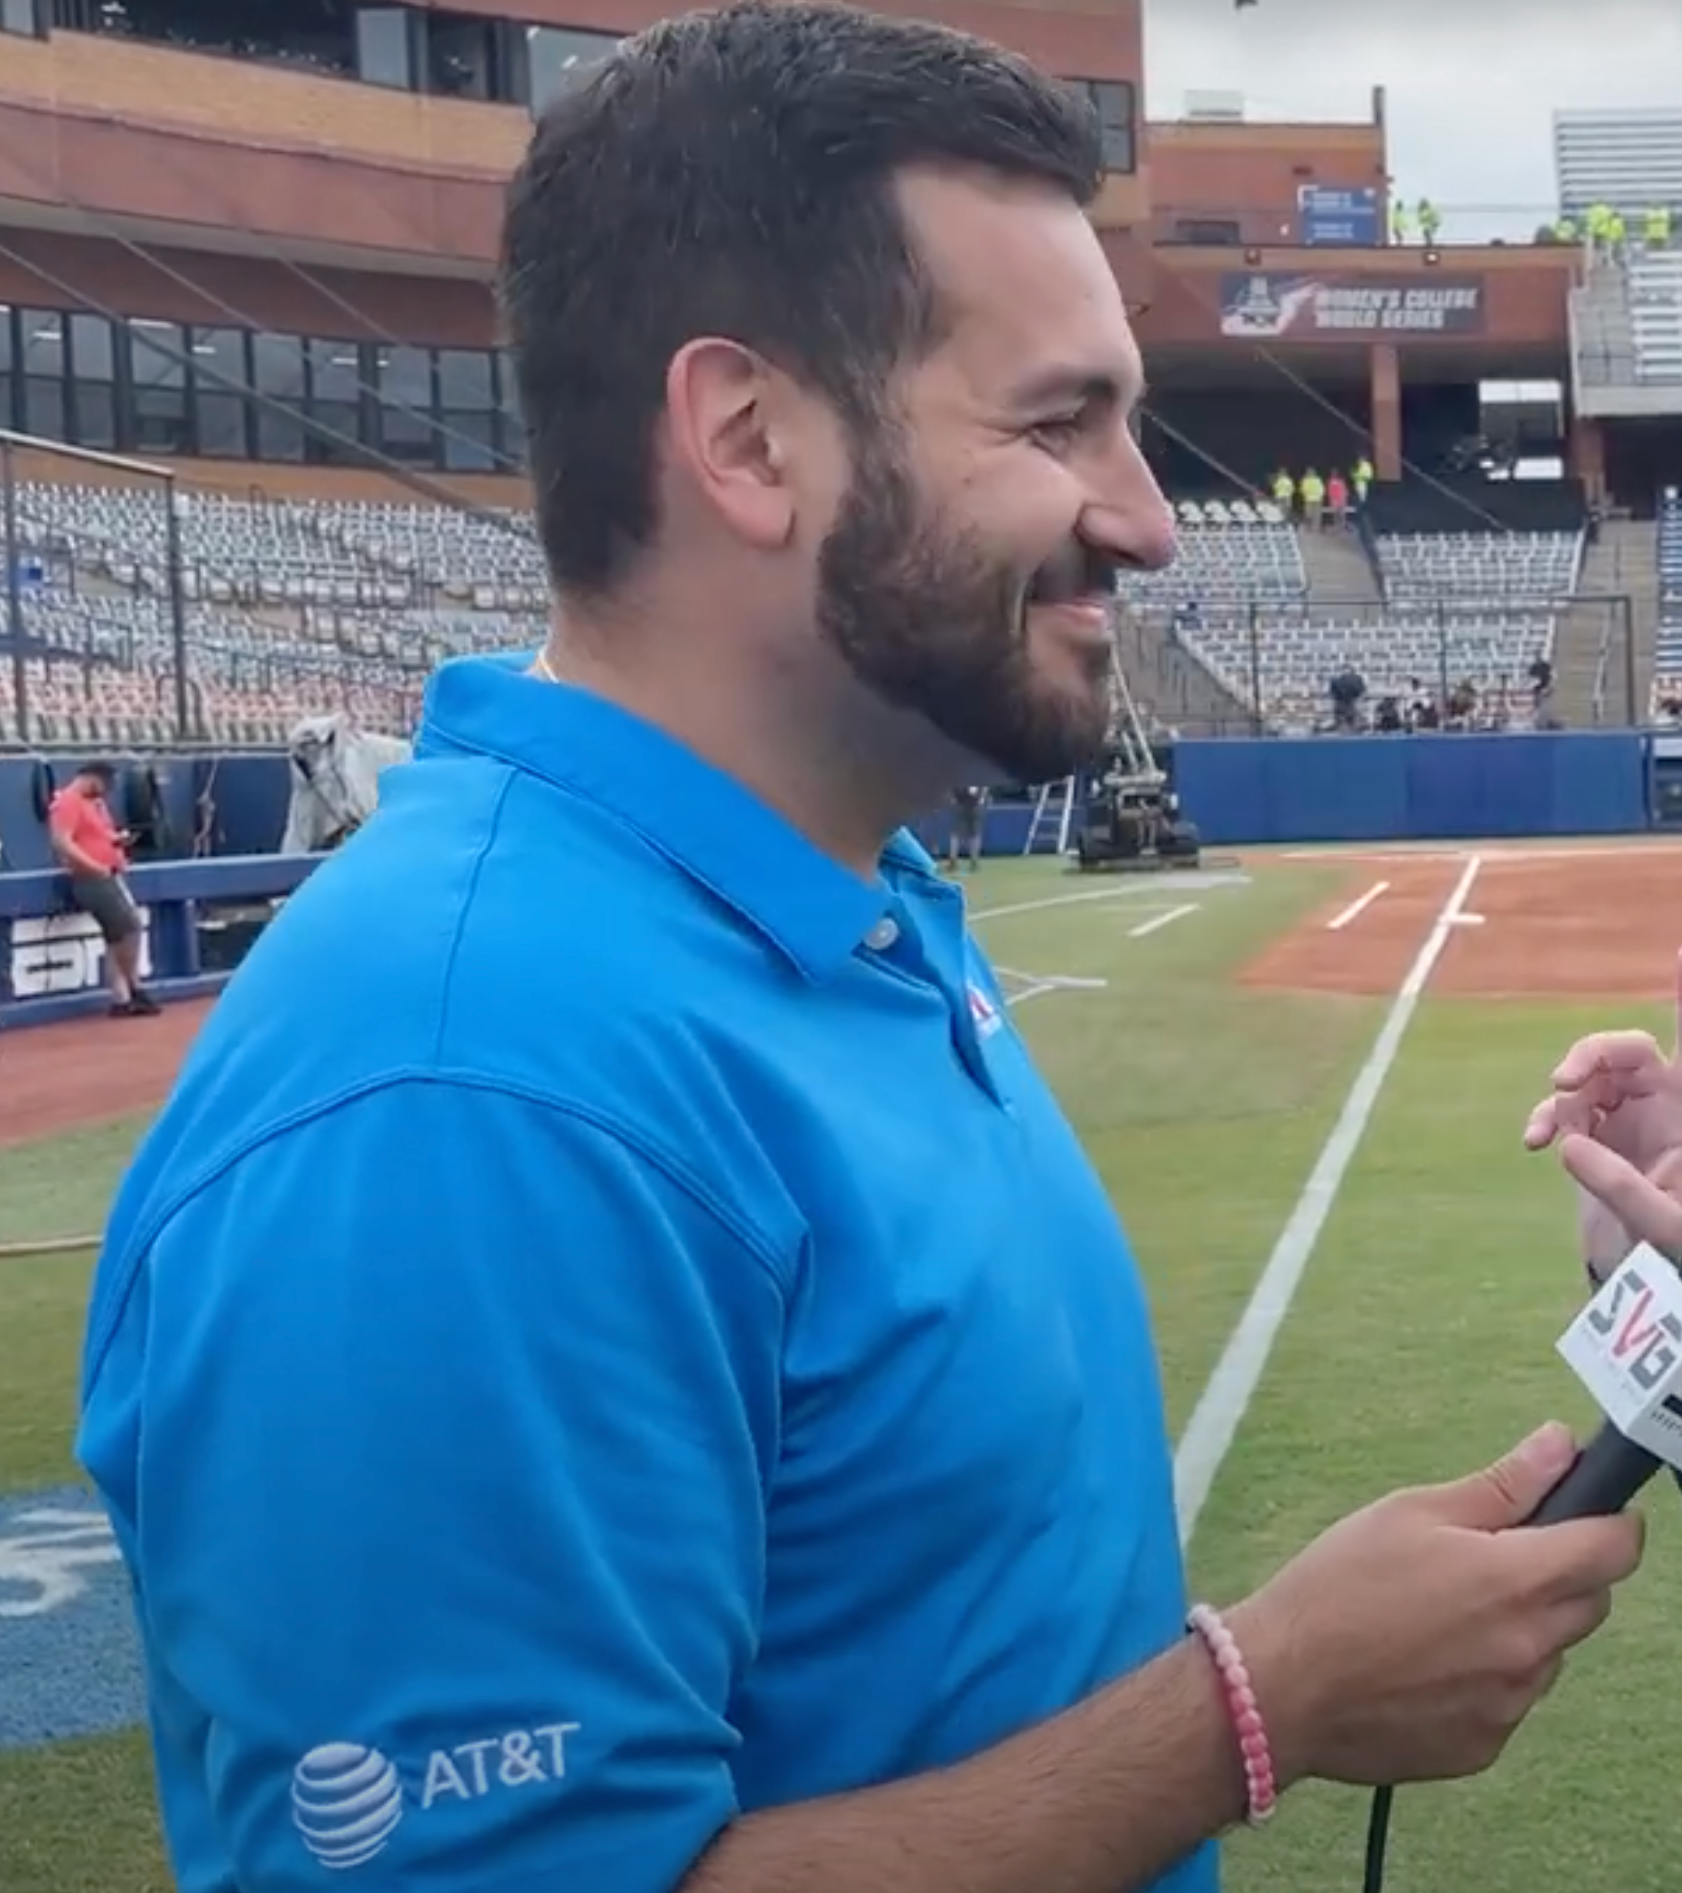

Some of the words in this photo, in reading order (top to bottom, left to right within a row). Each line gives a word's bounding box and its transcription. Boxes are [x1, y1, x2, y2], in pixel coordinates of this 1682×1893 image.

[1316, 288, 1401, 308] WOMEN'S
[1406, 288, 1478, 308] COLLEGE
[1316, 309, 1377, 329] WORLD
[1381, 309, 1444, 329] SERIES
[421, 1721, 582, 1809] AT&T
